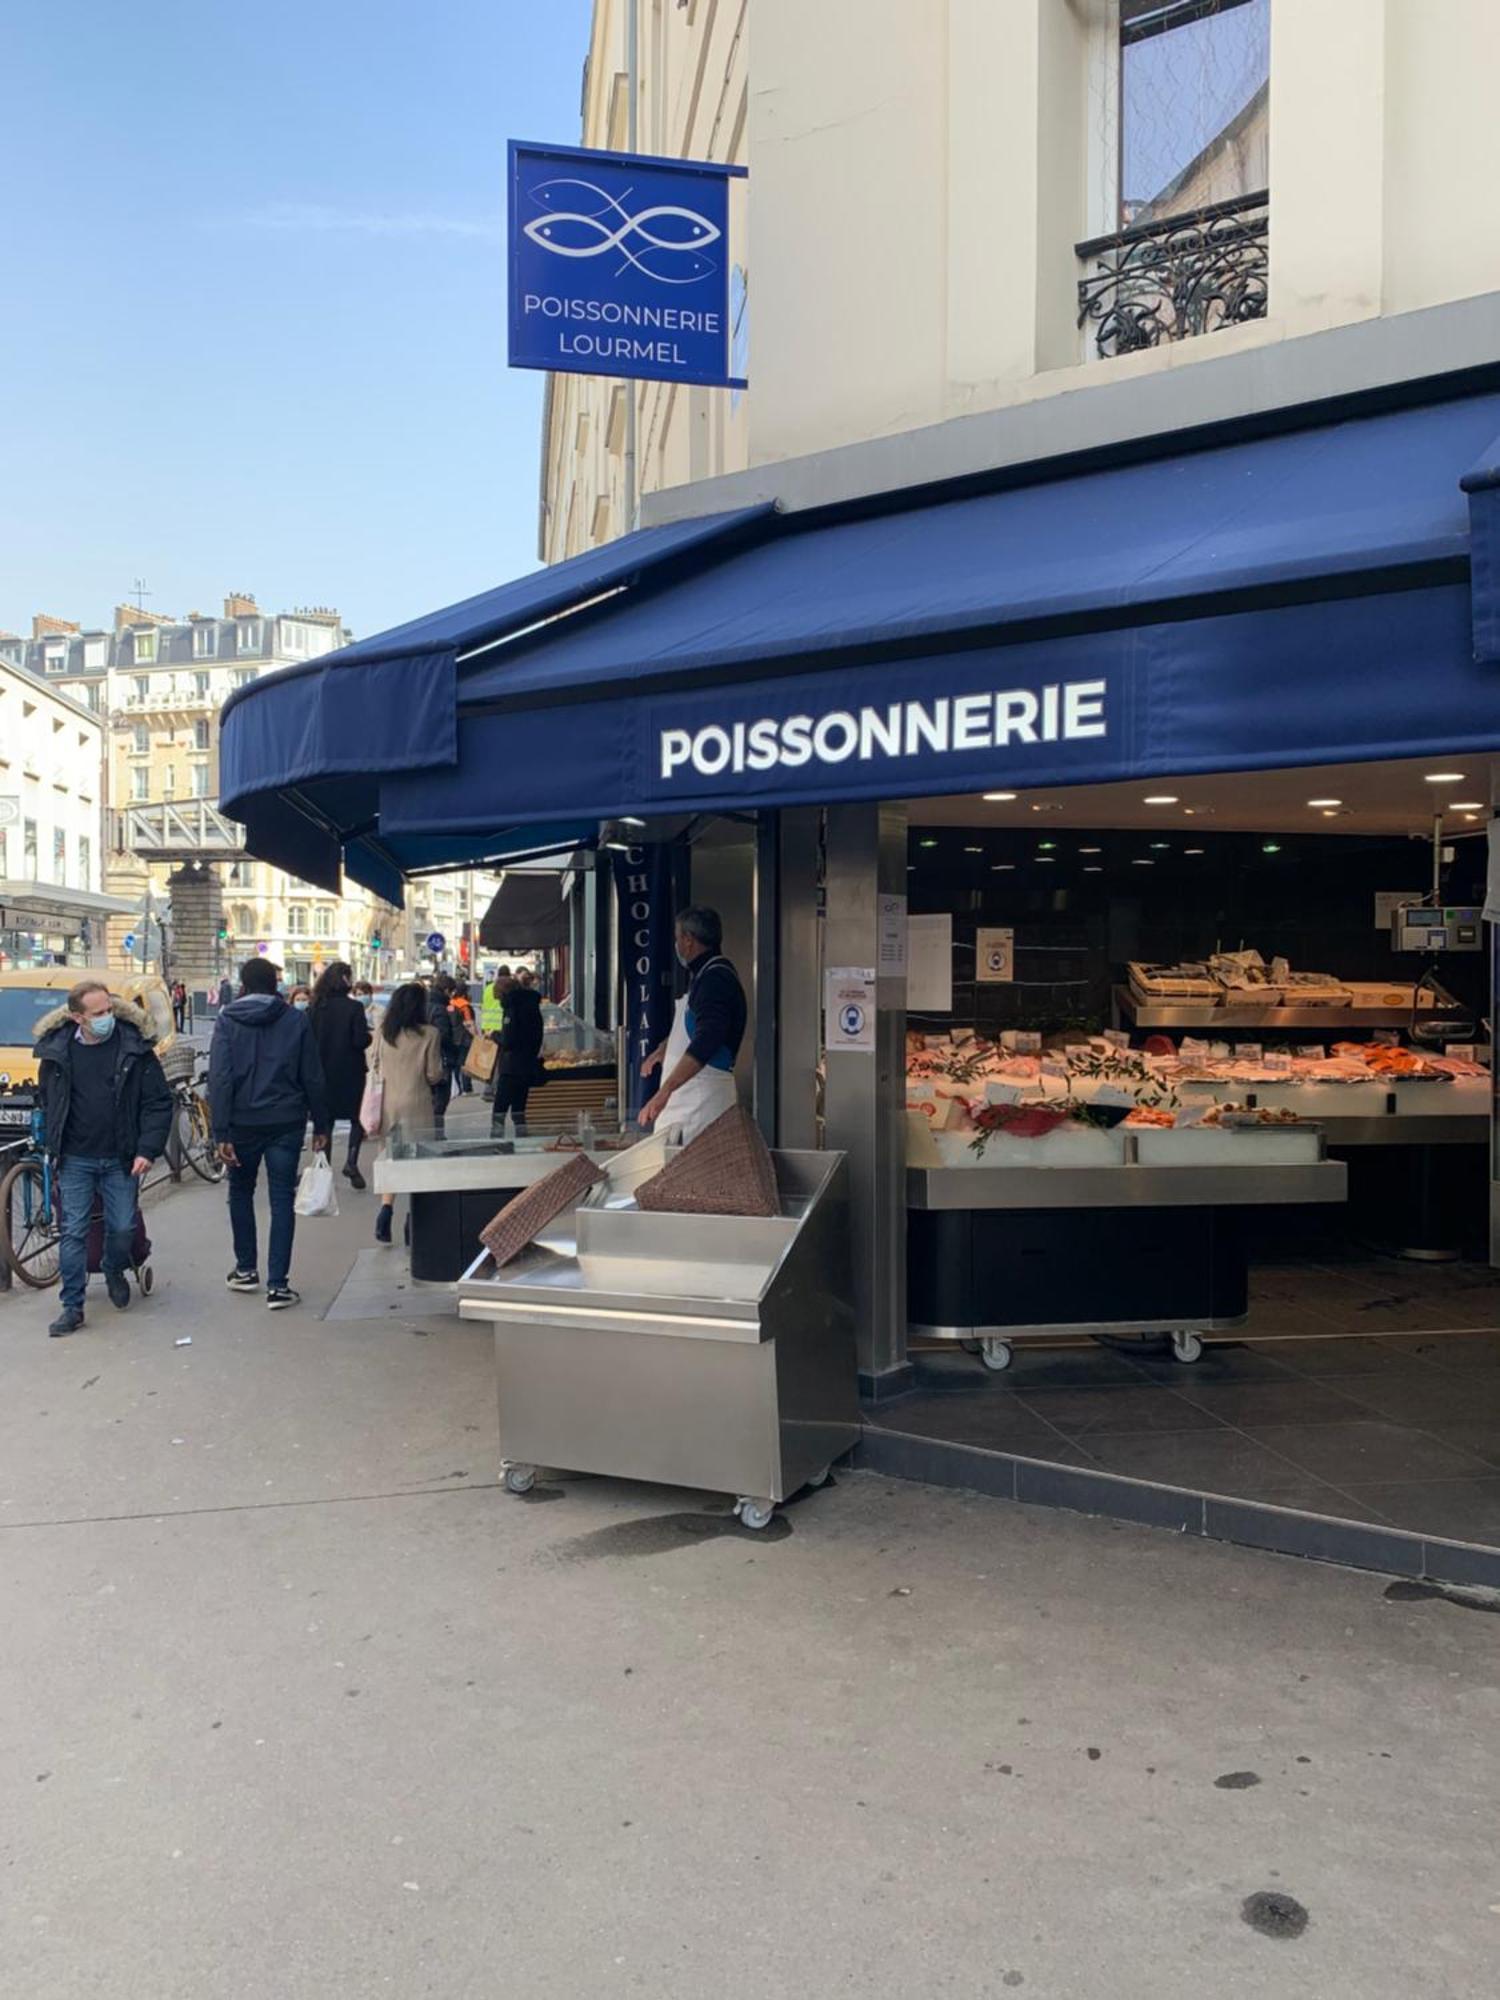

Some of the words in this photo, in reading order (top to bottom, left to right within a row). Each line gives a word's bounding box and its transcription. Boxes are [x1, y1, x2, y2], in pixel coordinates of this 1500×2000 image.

[524, 294, 719, 333] POISSONNERIE
[559, 332, 687, 364] LOURMEL
[660, 678, 1107, 779] POISSONNERIE
[625, 846, 651, 1057] CHOCOLAT
